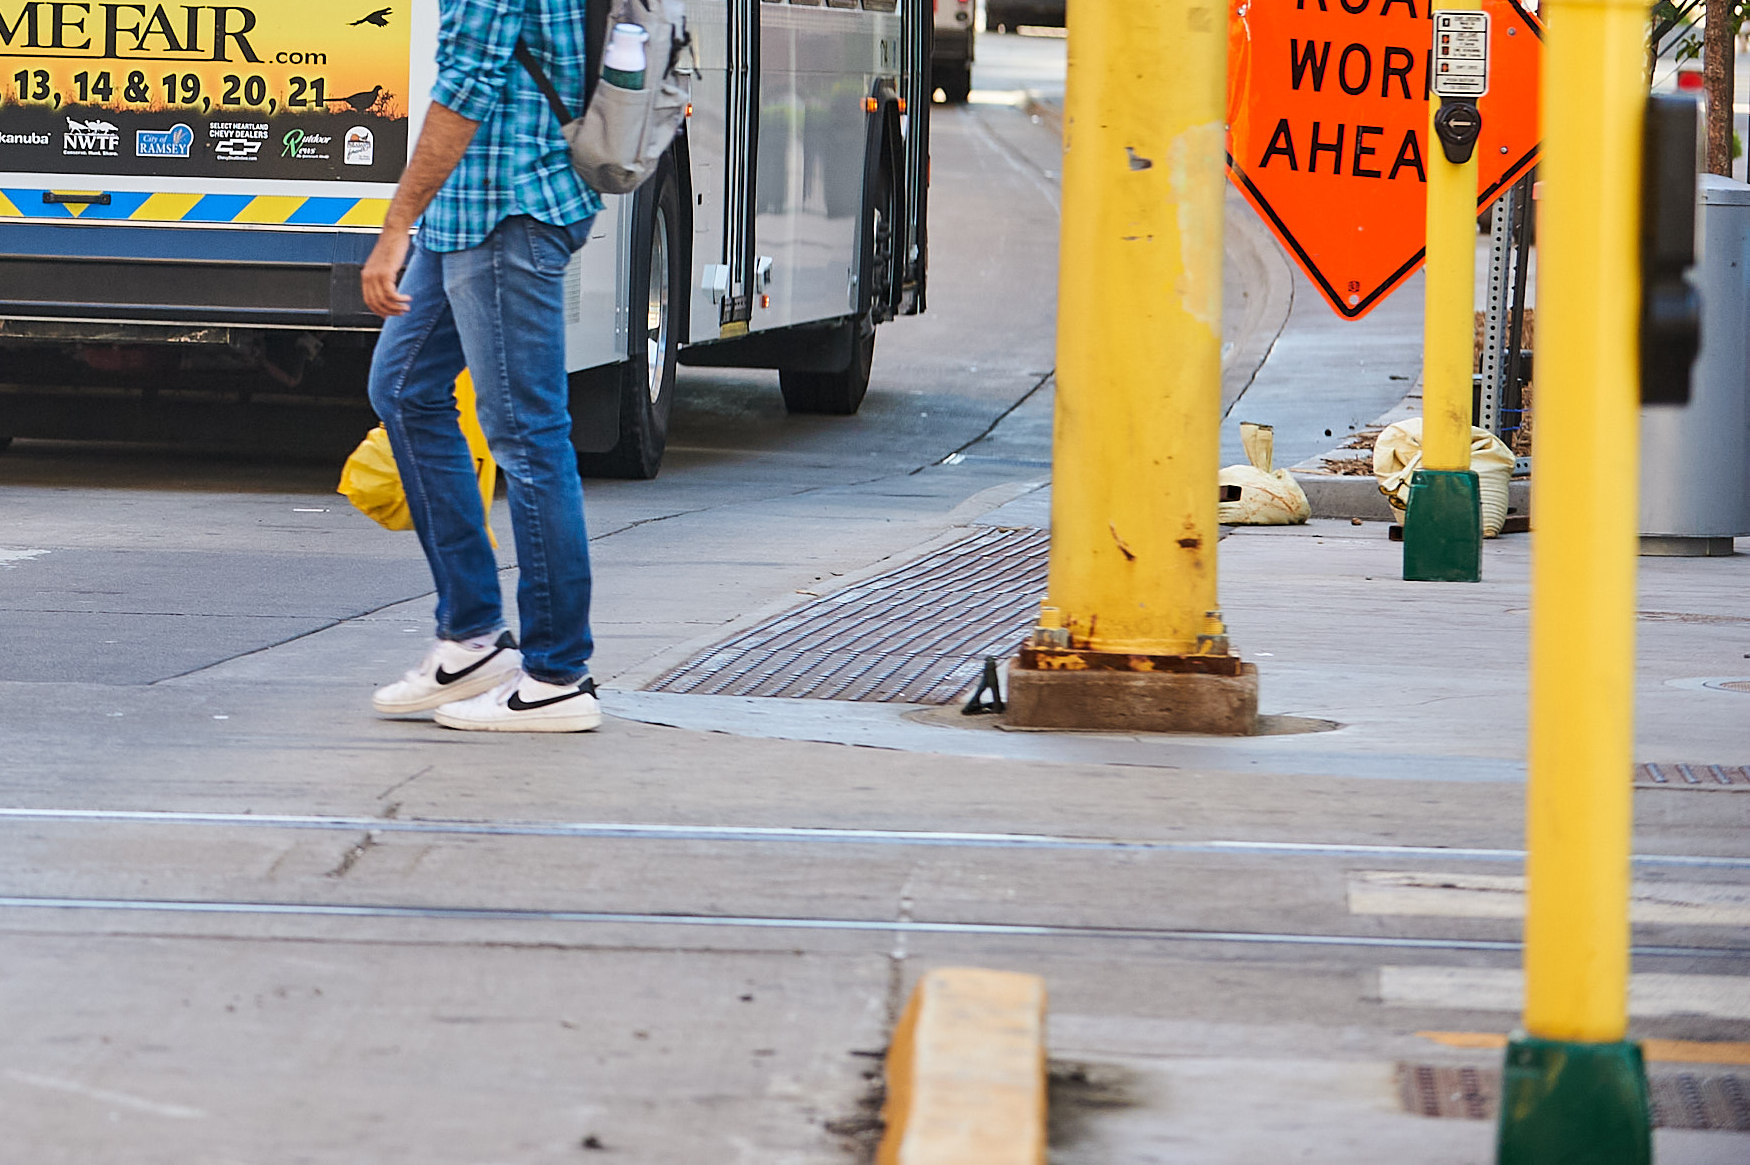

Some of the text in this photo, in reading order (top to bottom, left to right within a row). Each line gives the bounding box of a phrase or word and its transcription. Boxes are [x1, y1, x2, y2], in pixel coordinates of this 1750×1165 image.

[14, 69, 62, 110] 13,
[74, 71, 113, 102] 14
[123, 70, 150, 103] &
[162, 73, 211, 114] 19,
[222, 75, 276, 115] 20,
[288, 77, 326, 108] 21
[210, 122, 269, 131] SELECT HEARTLAND
[143, 134, 169, 143] City of
[209, 129, 269, 139] CHEVY DEALERS
[63, 135, 120, 151] NWTF
[140, 143, 187, 155] RAMSEY
[1259, 118, 1427, 183] AHEA
